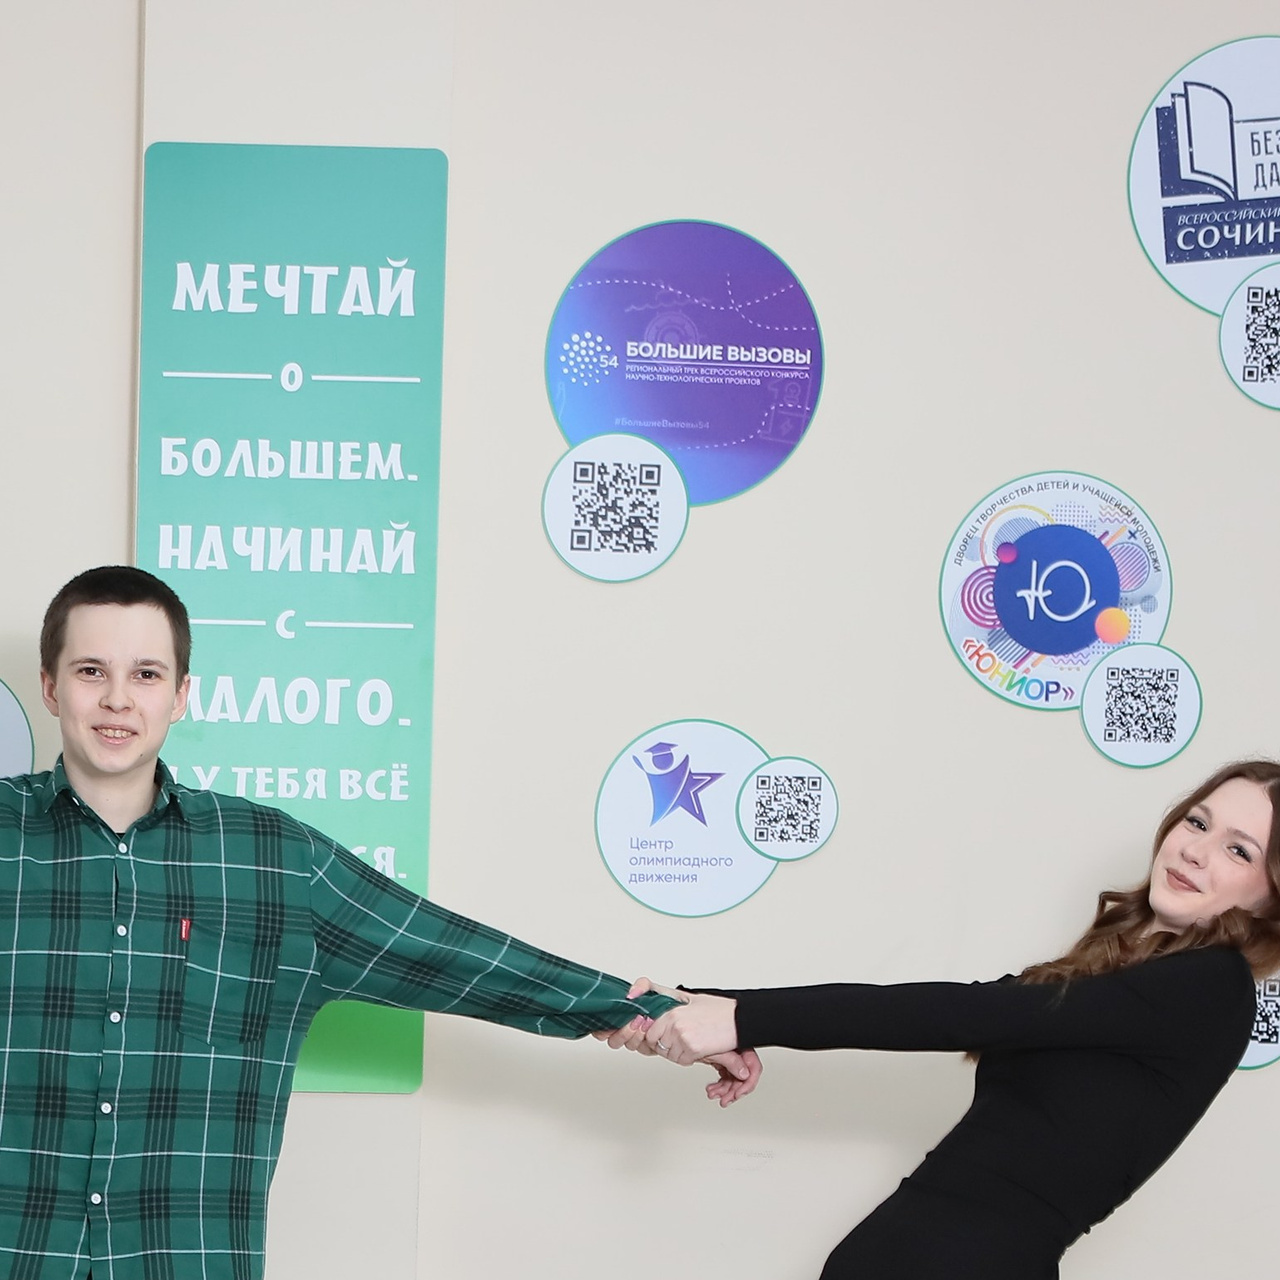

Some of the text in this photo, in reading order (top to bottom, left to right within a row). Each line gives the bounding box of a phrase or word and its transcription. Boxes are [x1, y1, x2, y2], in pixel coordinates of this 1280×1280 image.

[1253, 162, 1280, 191] ДА
[1177, 221, 1280, 250] СОЧИН
[172, 256, 416, 317] МЕЧТАЙ
[599, 355, 619, 369] 54
[626, 341, 811, 365] БОЛЬШИЕ ВЫЗОВЫ
[280, 362, 303, 392] О
[625, 365, 683, 374] РЕГИОНАЛЬНЫЙ
[771, 371, 810, 380] КОНКУРСА
[725, 377, 761, 386] ПРОЕКТОВ
[160, 437, 418, 481] БОЛЬШЕМ.
[954, 480, 1161, 573] ДВОРЕЦ ТВОРЧЕСТВА ДЕТЕЙ И УЧАЩЕЙСЯ МОЛОДЕЖИ
[158, 519, 416, 575] НАЧИНАЙ
[275, 610, 297, 639] С
[962, 639, 1075, 702] «ЮНИОР»
[231, 767, 327, 800] ТЕБЯ
[339, 763, 409, 801] ВСЁ
[629, 837, 674, 852] Центр
[629, 855, 734, 868] олимпиадного
[628, 872, 698, 884] движения
